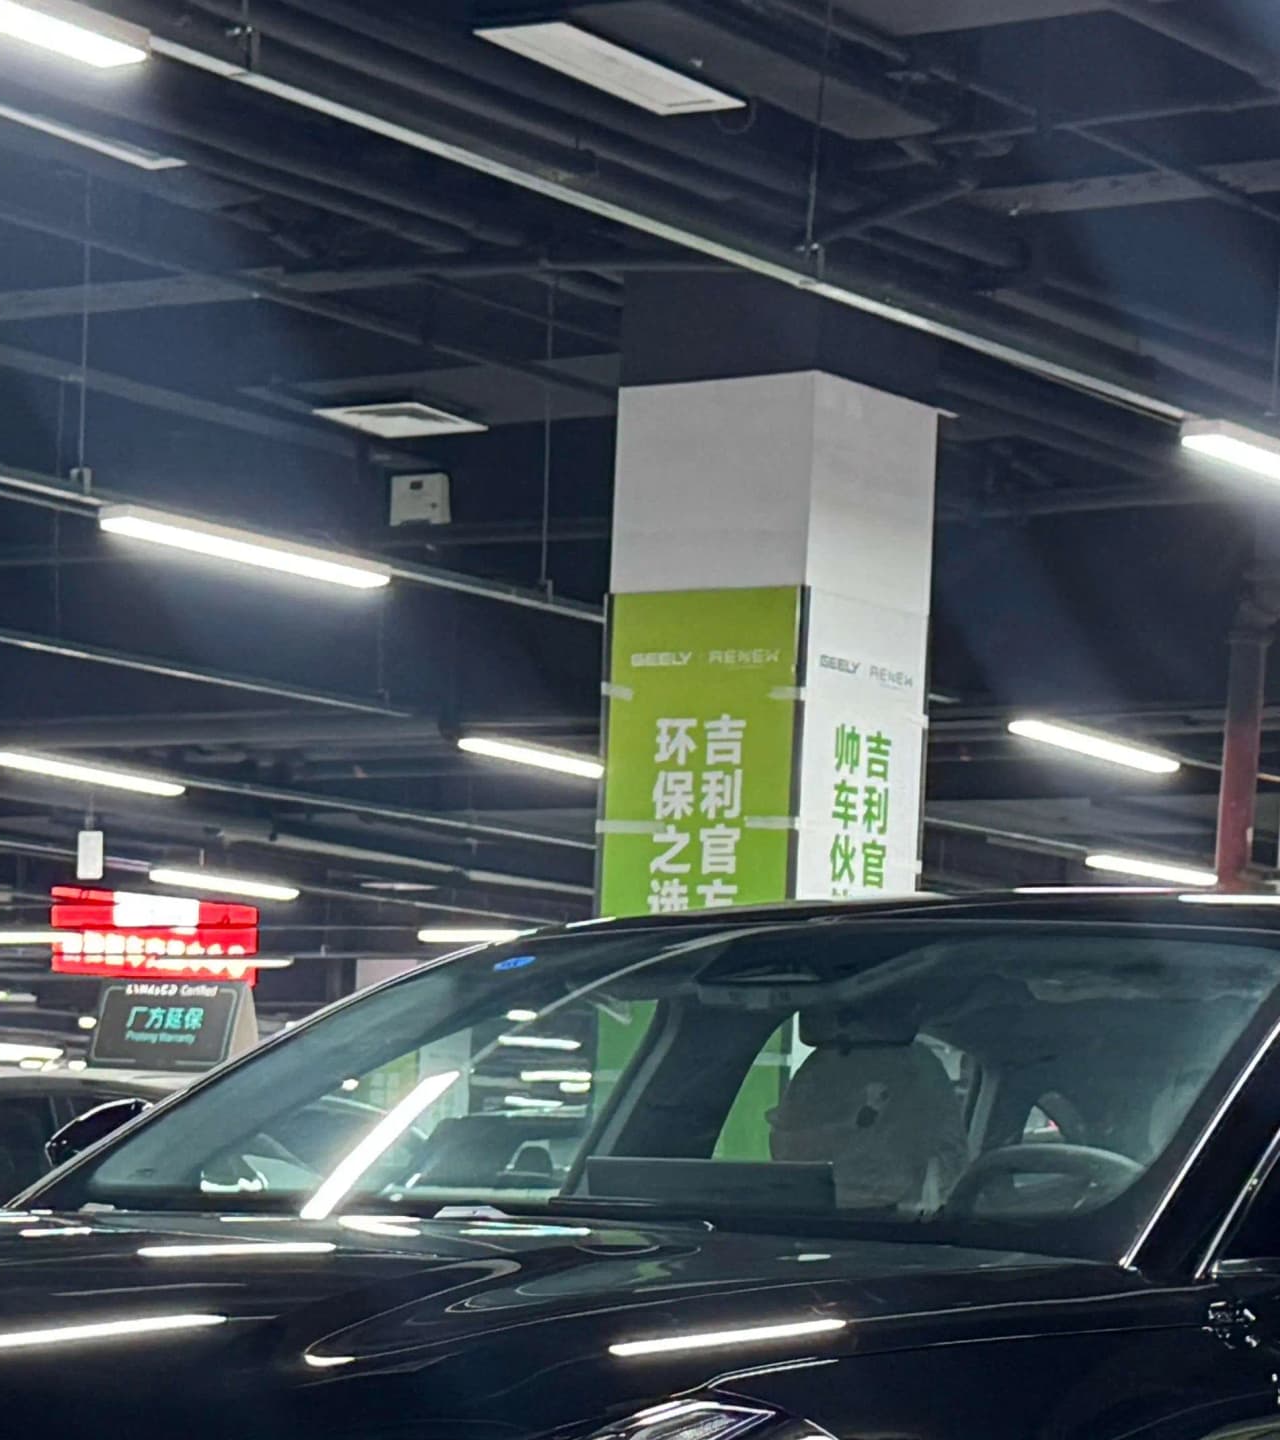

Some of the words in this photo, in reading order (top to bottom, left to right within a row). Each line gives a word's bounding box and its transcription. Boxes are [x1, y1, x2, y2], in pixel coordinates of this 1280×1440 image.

[631, 652, 693, 668] GEELY
[820, 654, 861, 675] GEELY
[829, 723, 861, 897] 帅车伙
[861, 731, 892, 889] 吉利官
[126, 1006, 204, 1030] 厂方延保
